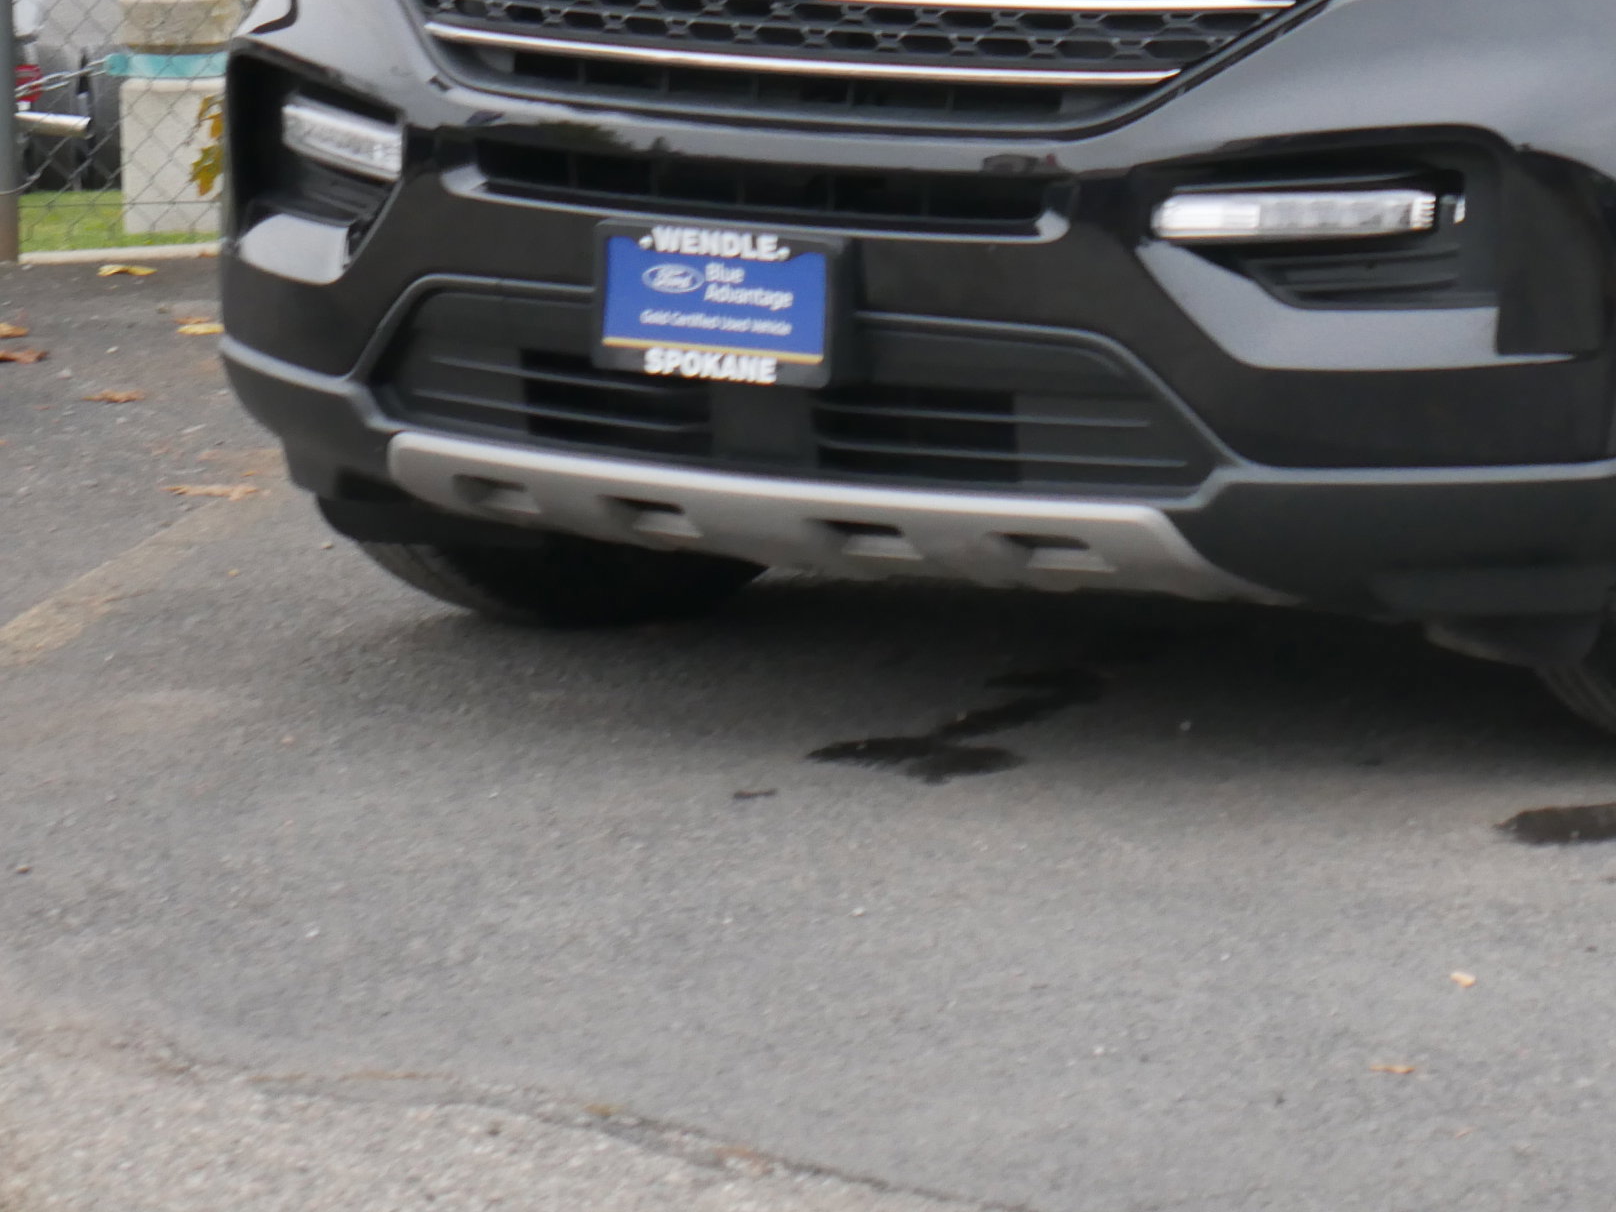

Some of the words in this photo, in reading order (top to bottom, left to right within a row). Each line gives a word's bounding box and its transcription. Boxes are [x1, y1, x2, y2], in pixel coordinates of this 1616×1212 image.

[651, 225, 779, 262] WENDLE
[705, 262, 745, 284] Blue
[704, 282, 794, 311] Advantage
[643, 347, 778, 384] SPOKANE
